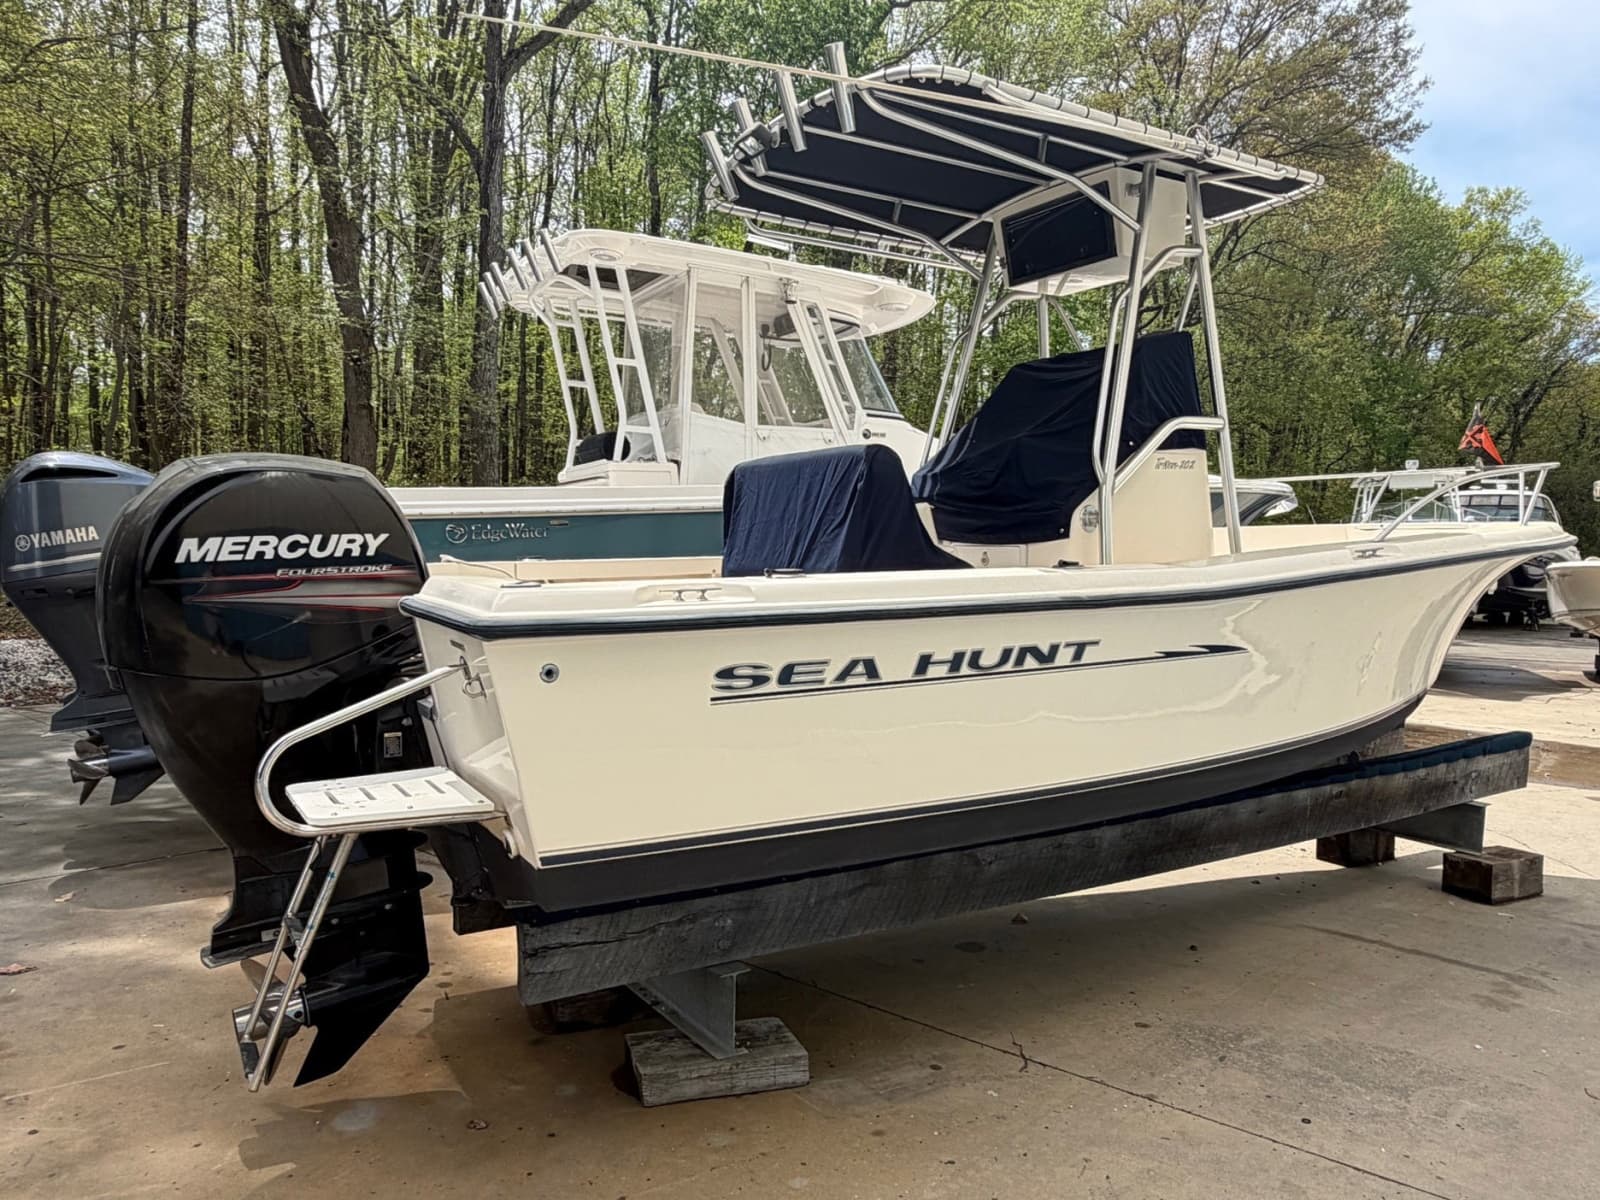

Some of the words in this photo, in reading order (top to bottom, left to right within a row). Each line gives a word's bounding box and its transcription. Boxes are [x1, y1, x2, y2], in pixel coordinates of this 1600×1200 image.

[29, 525, 100, 549] YAMAHA
[471, 523, 549, 542] EdgeWater
[174, 533, 390, 564] MERCURY
[711, 656, 883, 693] SEA
[911, 639, 1101, 678] HUNT
